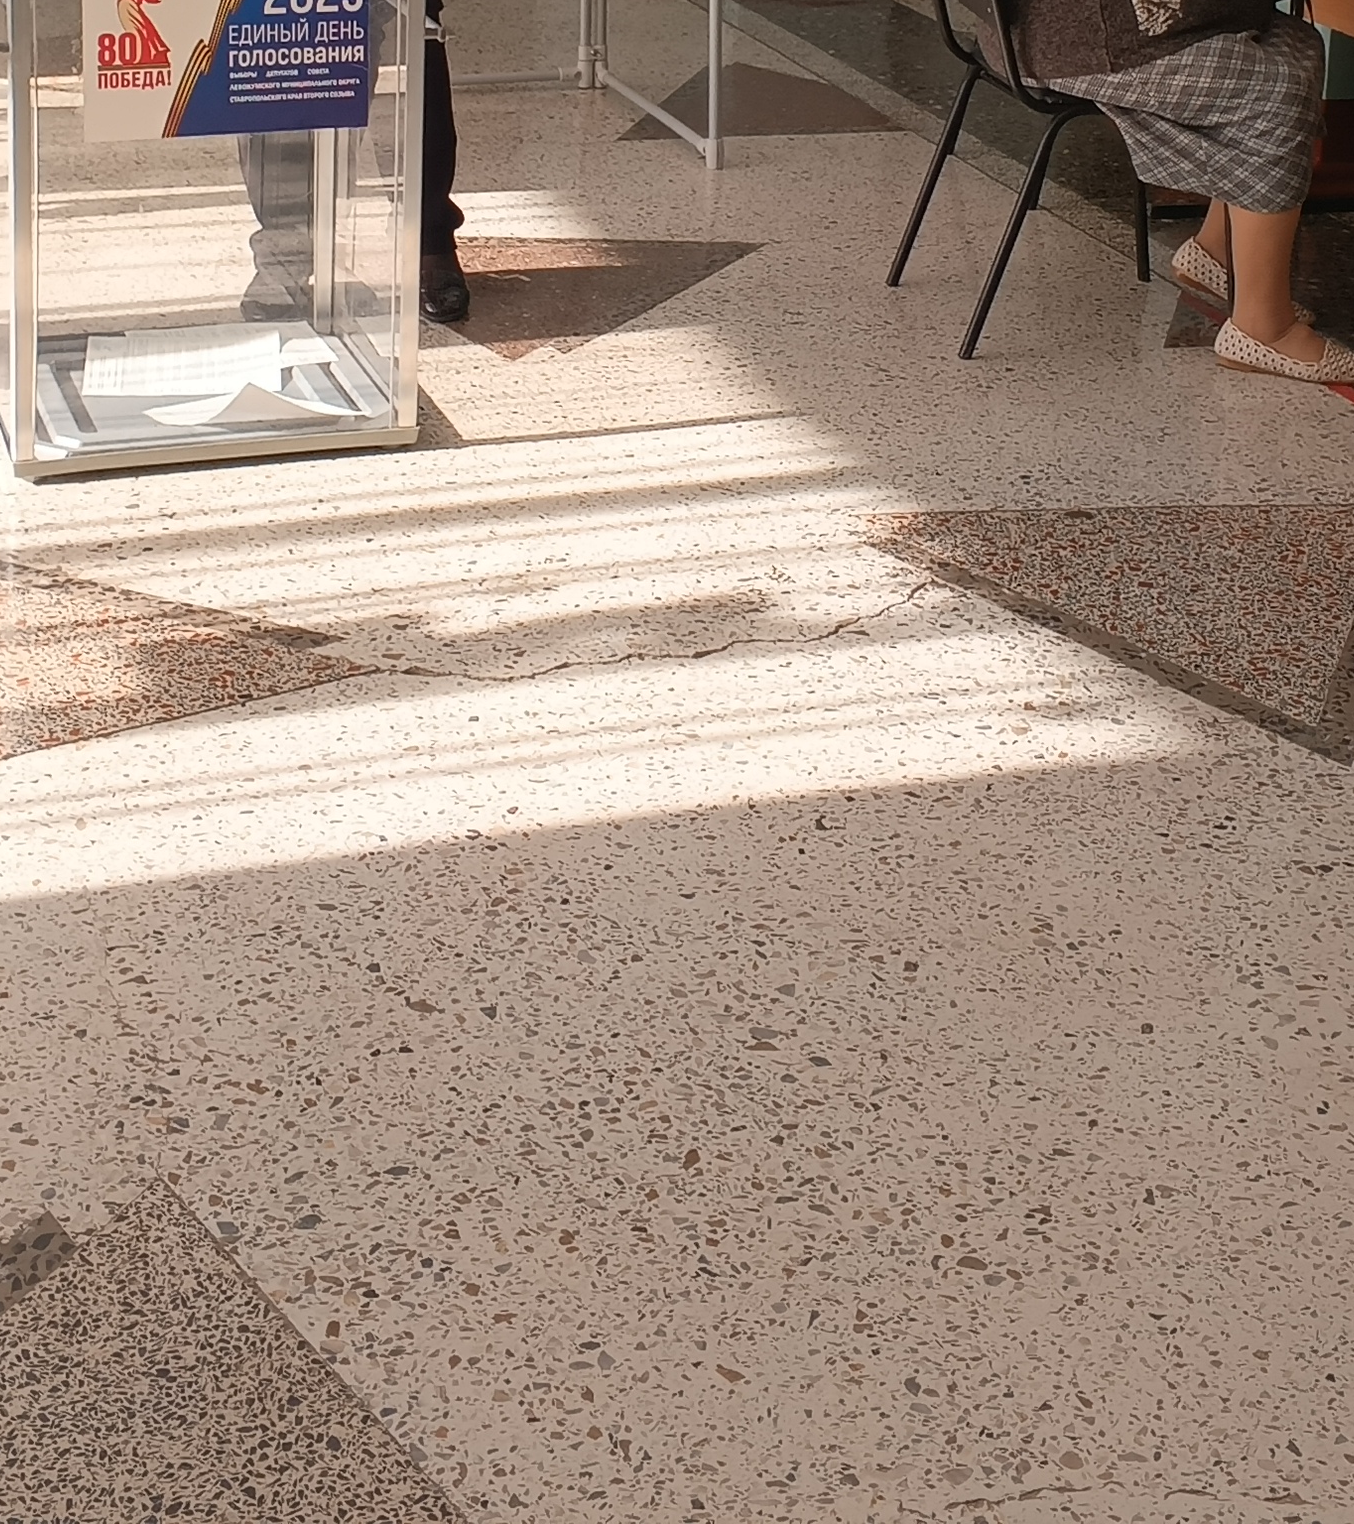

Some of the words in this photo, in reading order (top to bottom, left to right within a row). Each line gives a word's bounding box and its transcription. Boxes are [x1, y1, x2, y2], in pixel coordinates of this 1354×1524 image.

[229, 18, 309, 45] ЕДИНЫЙ
[315, 21, 364, 43] ДЕНЬ
[98, 33, 137, 66] 80
[98, 70, 172, 90] ПОБЕДА!
